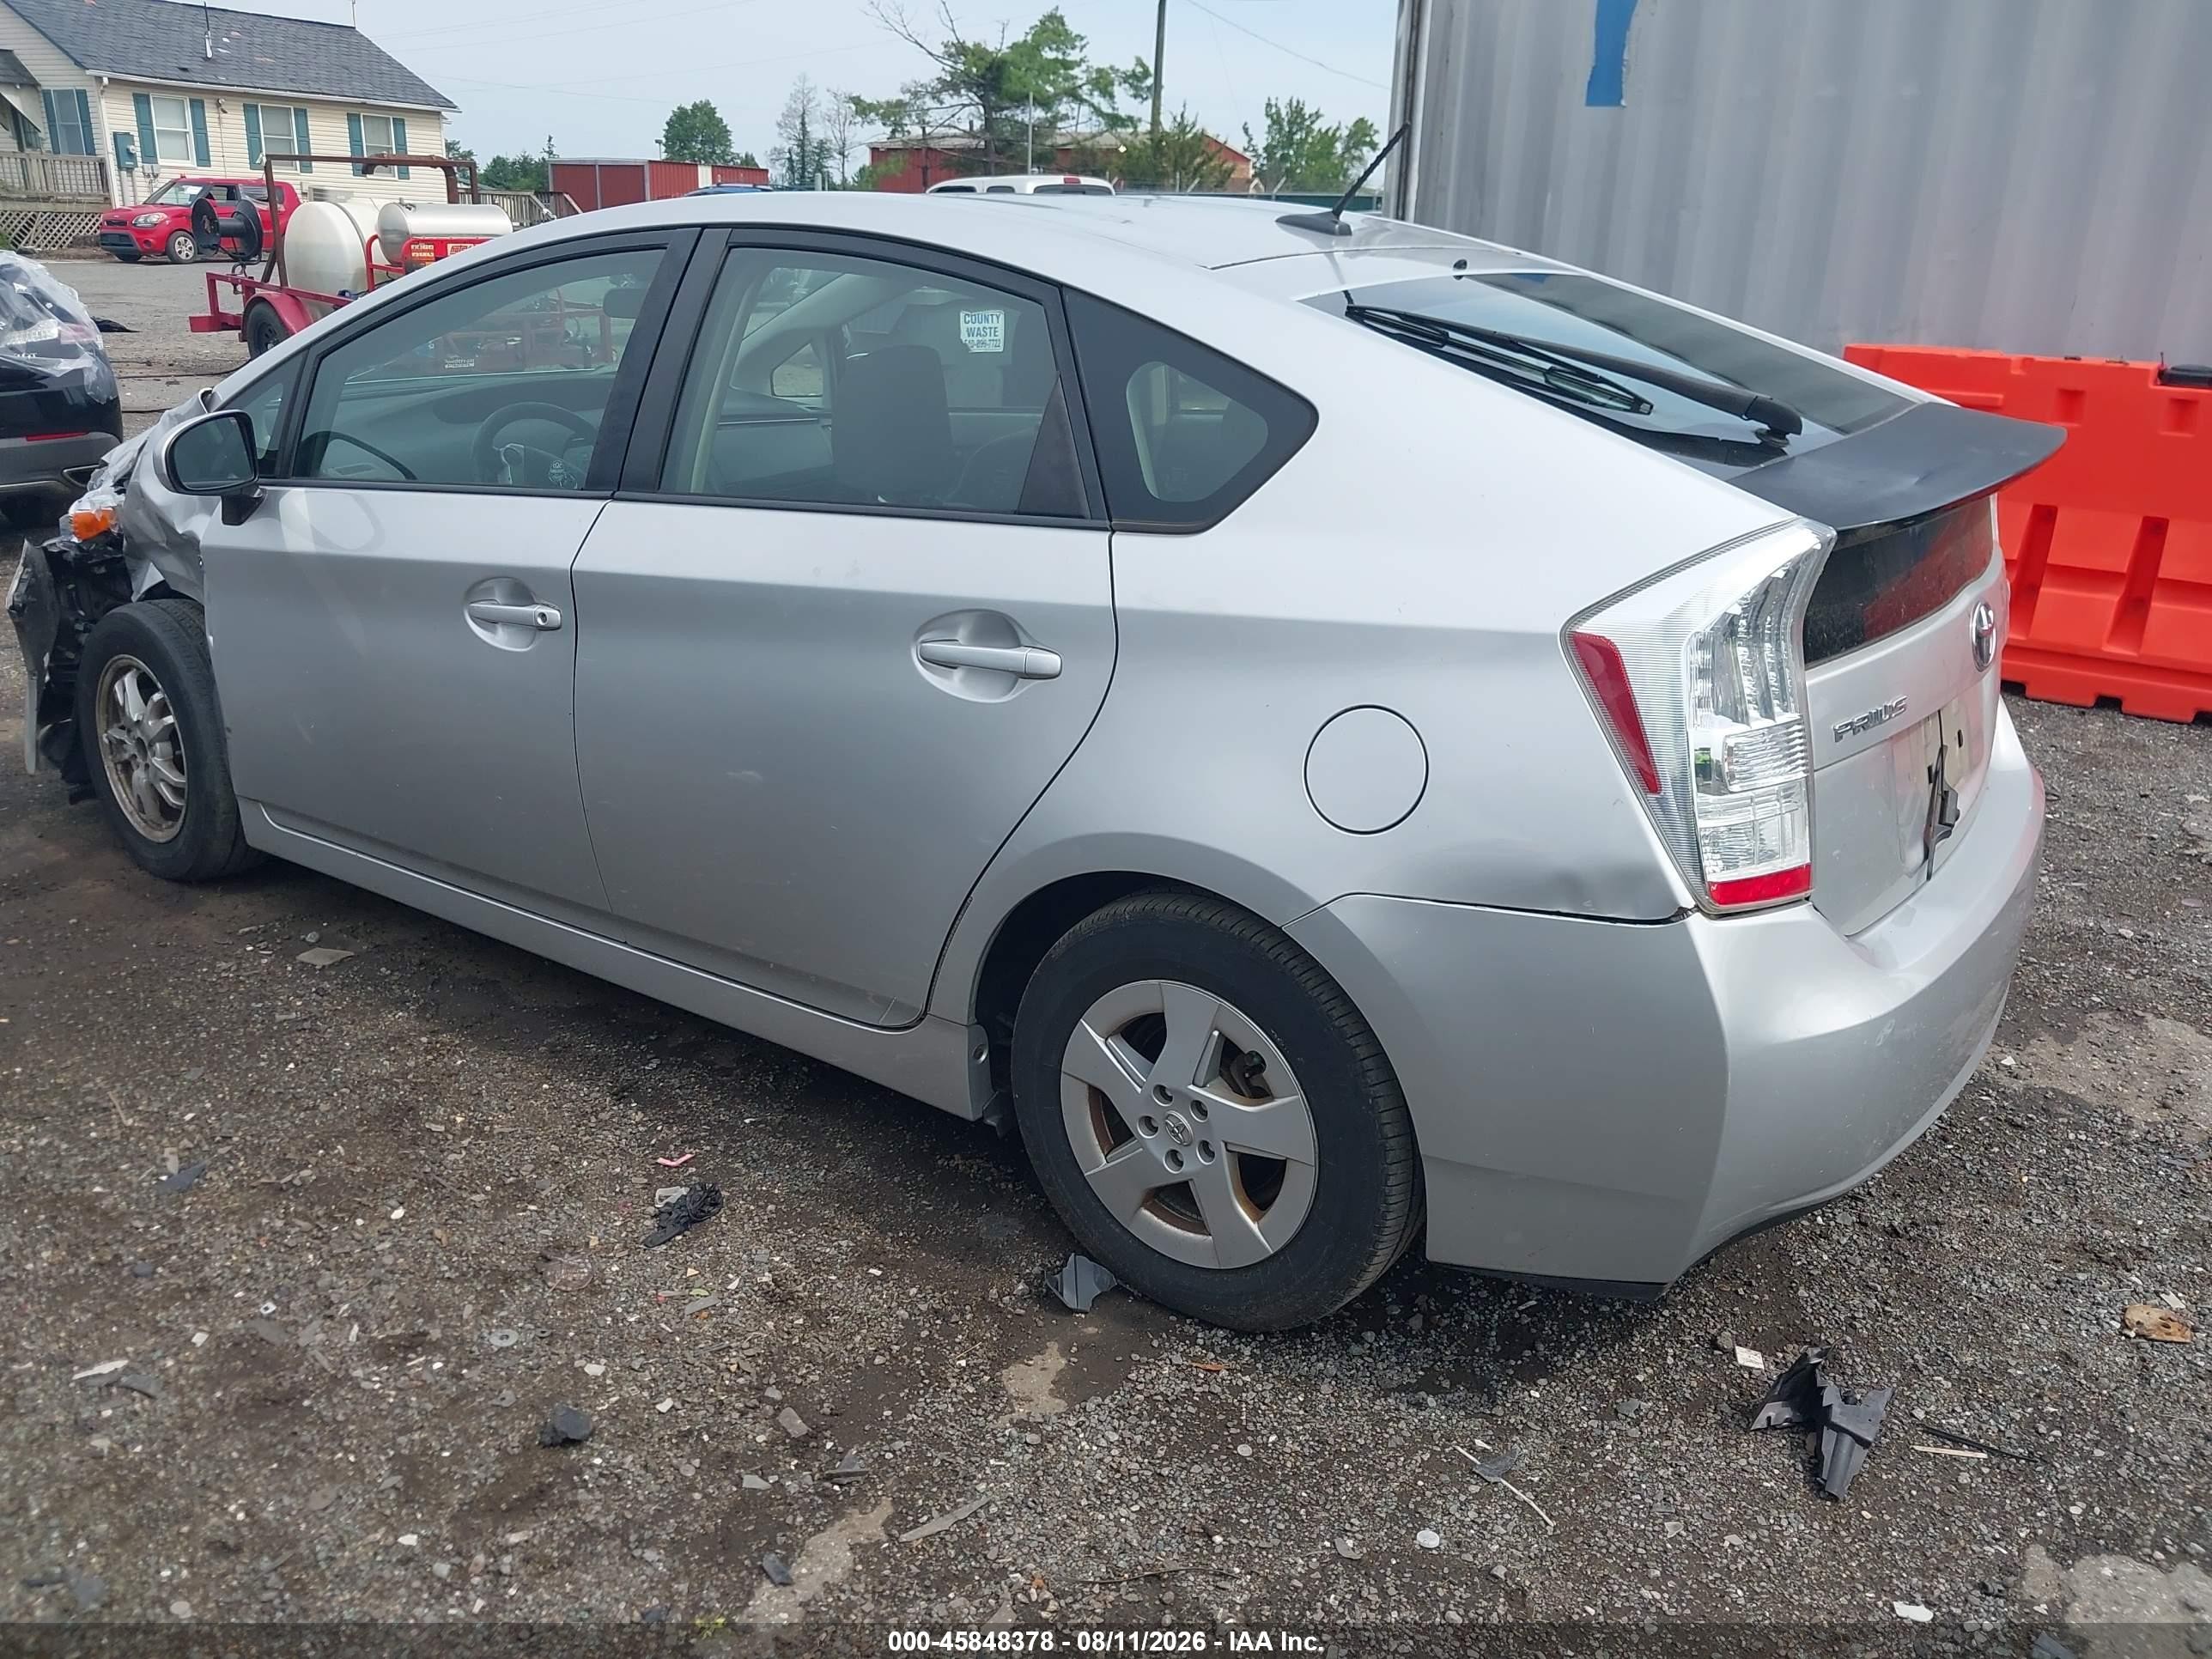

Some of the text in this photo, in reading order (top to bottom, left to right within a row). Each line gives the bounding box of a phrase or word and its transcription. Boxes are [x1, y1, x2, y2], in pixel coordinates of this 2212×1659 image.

[963, 313, 1001, 325] COUNTY
[966, 326, 999, 337] WASTE
[1832, 696, 1908, 743] PRIUS
